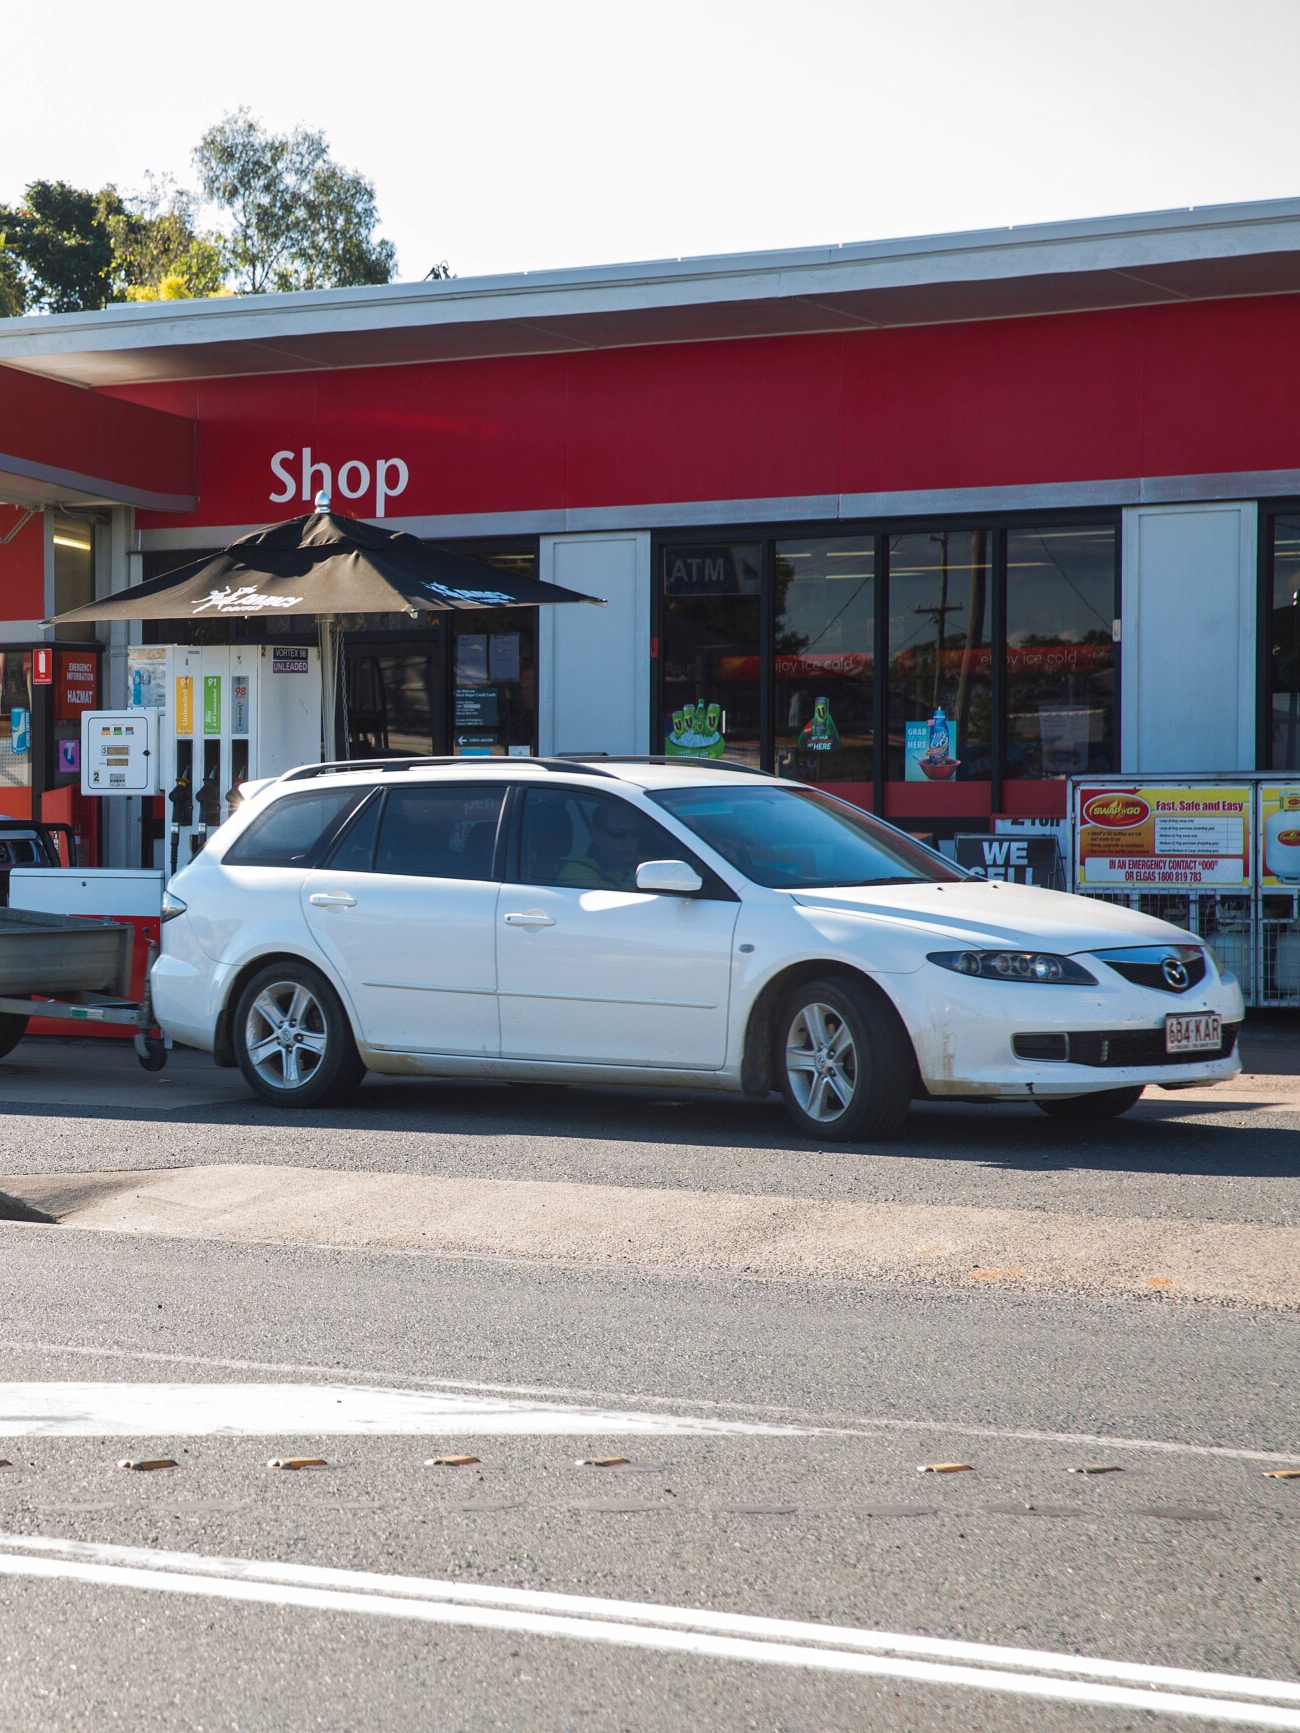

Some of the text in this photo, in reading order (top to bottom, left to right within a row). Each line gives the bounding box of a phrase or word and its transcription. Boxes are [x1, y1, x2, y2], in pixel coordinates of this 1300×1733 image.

[269, 447, 409, 518] Shop
[669, 558, 724, 582] ATM
[300, 650, 307, 658] 98
[1022, 652, 1042, 665] ice
[1046, 650, 1077, 664] cold
[68, 662, 92, 672] EMERGENCY
[274, 662, 308, 671] UNLEADED
[801, 659, 820, 671] ice
[824, 657, 853, 670] cold
[66, 672, 94, 681] INFORMATION
[208, 678, 217, 687] 91
[235, 686, 246, 696] 98
[67, 690, 93, 704] HAZMAT
[908, 741, 926, 749] HERE
[94, 772, 100, 782] 2
[1156, 800, 1244, 812] Fast, Safe and Easy
[982, 842, 1028, 865] WE
[1109, 860, 1116, 869] IN
[1117, 860, 1126, 869] AN
[1128, 860, 1167, 870] EMERGENCY
[1168, 860, 1197, 870] CONTACT
[1125, 871, 1202, 882] OR ELGAS 1800 819 783
